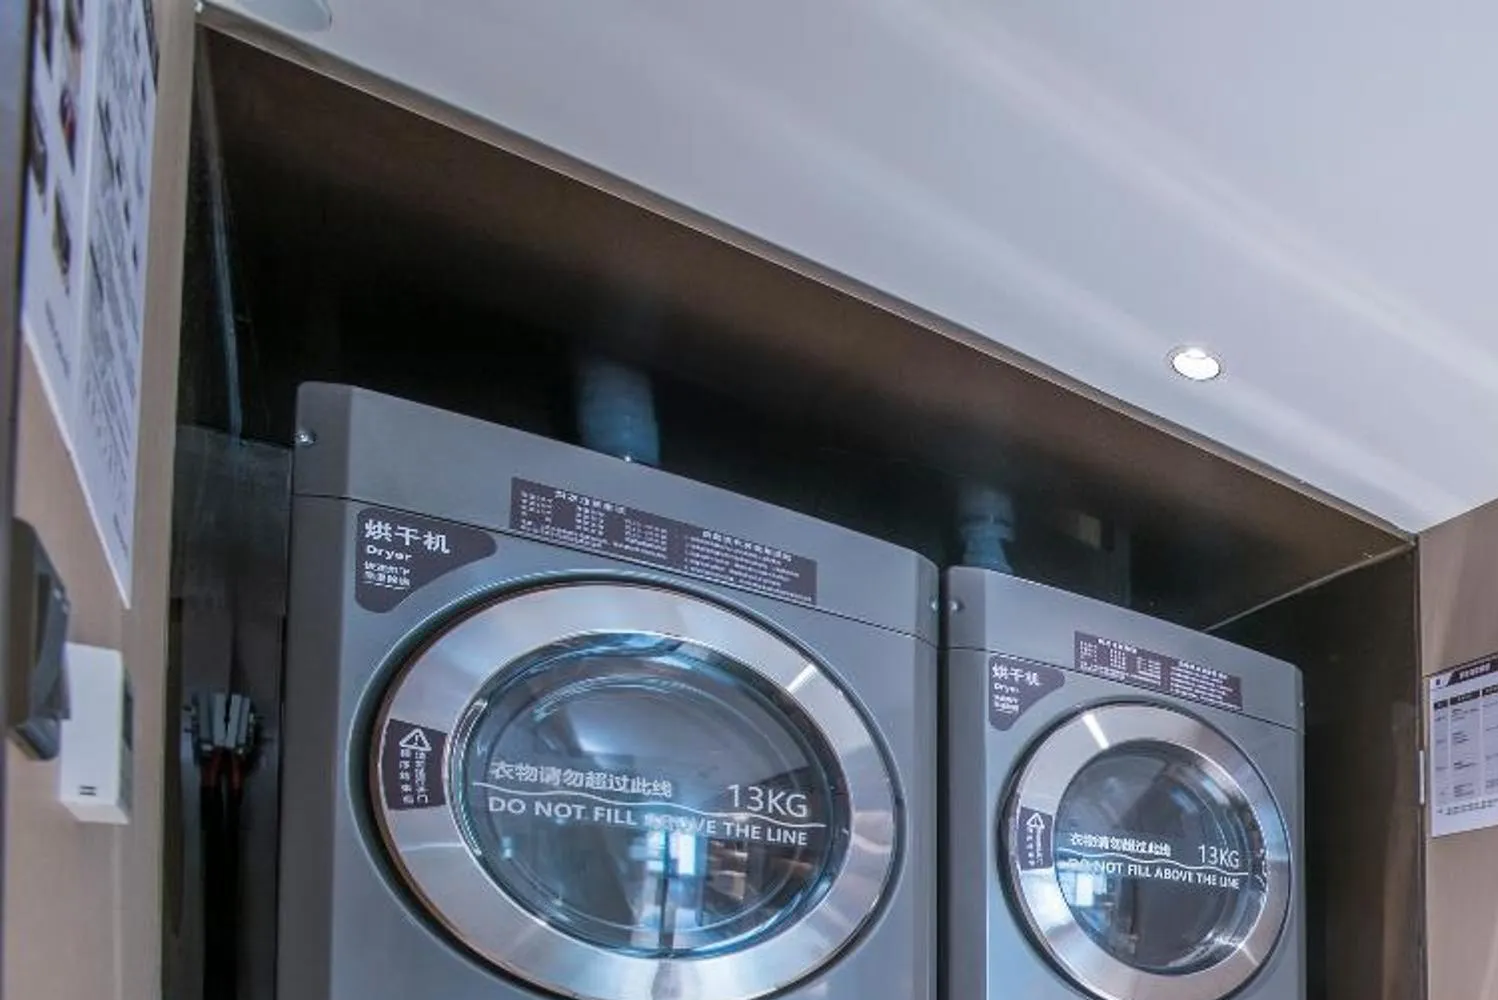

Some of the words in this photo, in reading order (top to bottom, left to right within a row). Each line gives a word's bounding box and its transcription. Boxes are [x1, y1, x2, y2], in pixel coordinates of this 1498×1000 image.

[365, 519, 450, 553] 烘干机
[366, 545, 412, 561] Dryer
[490, 761, 672, 797] 衣物请勿超过此线
[728, 783, 807, 817] 13KG
[488, 797, 526, 814] DO
[535, 801, 586, 820] NOT
[593, 806, 637, 826] FILL
[723, 821, 760, 840] THE
[767, 828, 808, 846] LINE
[1198, 844, 1239, 869] 13KG
[1154, 867, 1192, 883] ABOVE
[1196, 872, 1217, 886] THE
